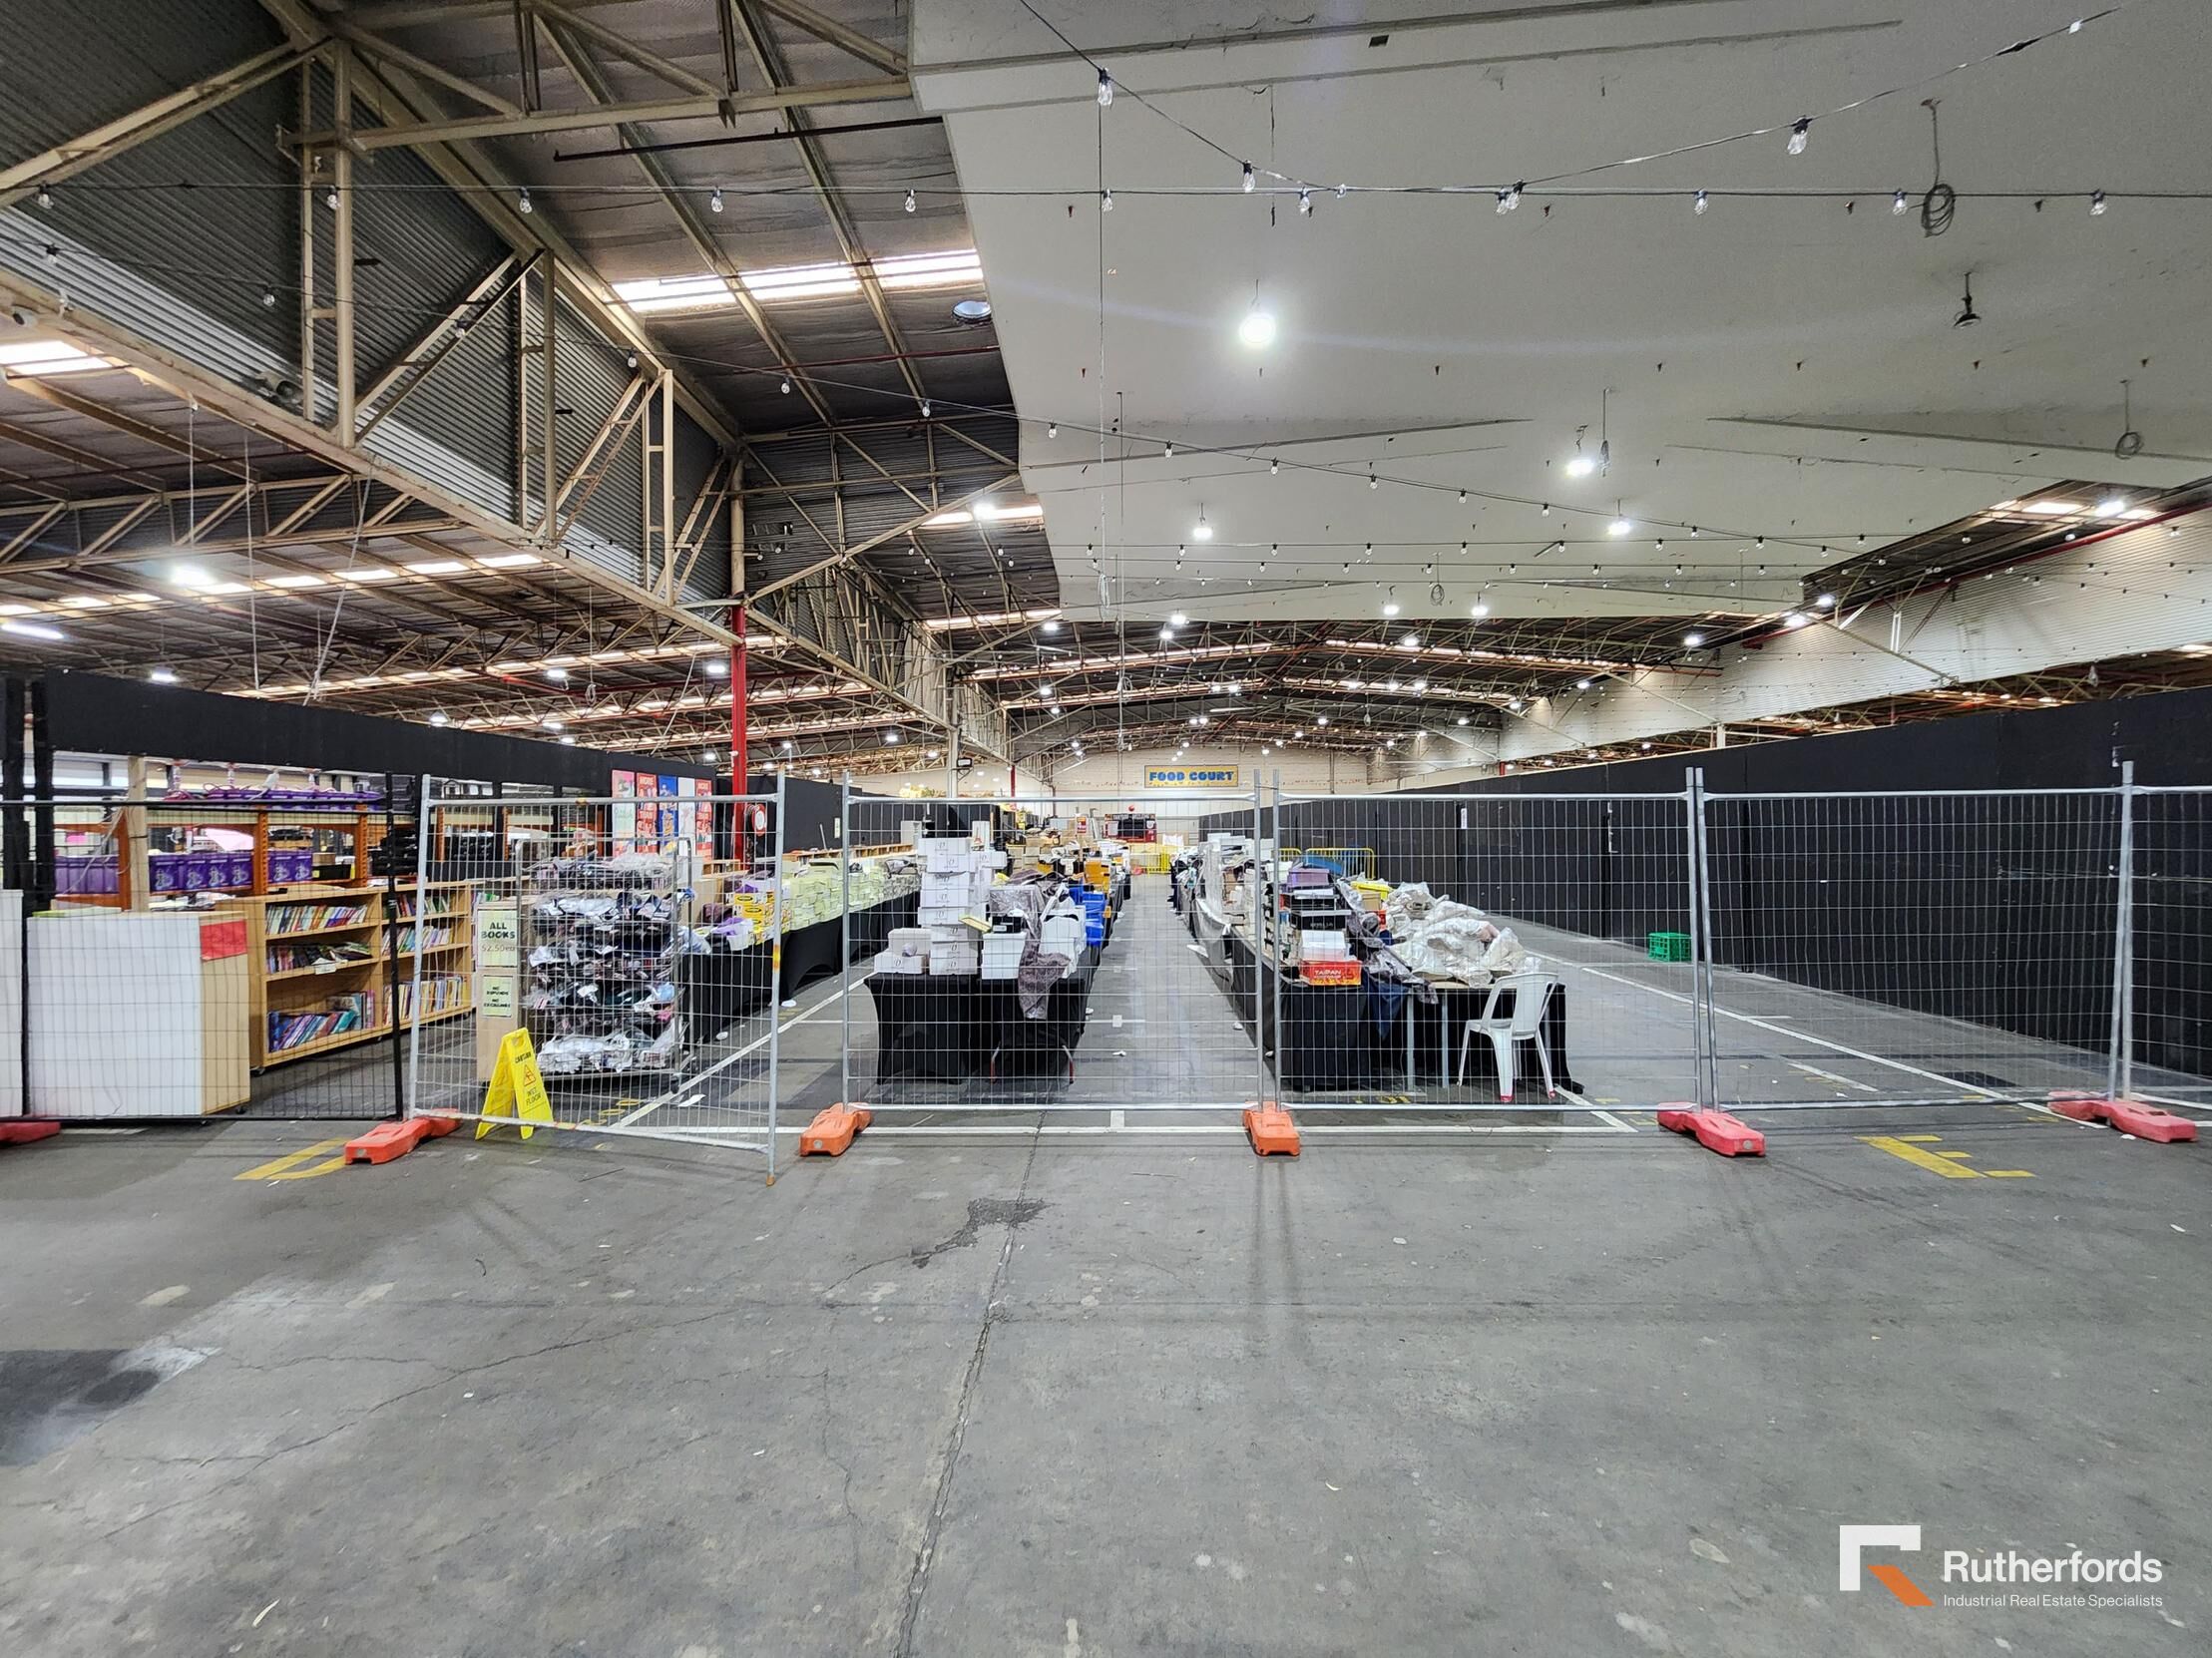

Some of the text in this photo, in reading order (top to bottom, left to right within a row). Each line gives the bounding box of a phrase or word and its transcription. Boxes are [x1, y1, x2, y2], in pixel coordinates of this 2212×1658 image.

[1148, 771, 1234, 781] FOOD COURT
[526, 1093, 541, 1106] FLOOR
